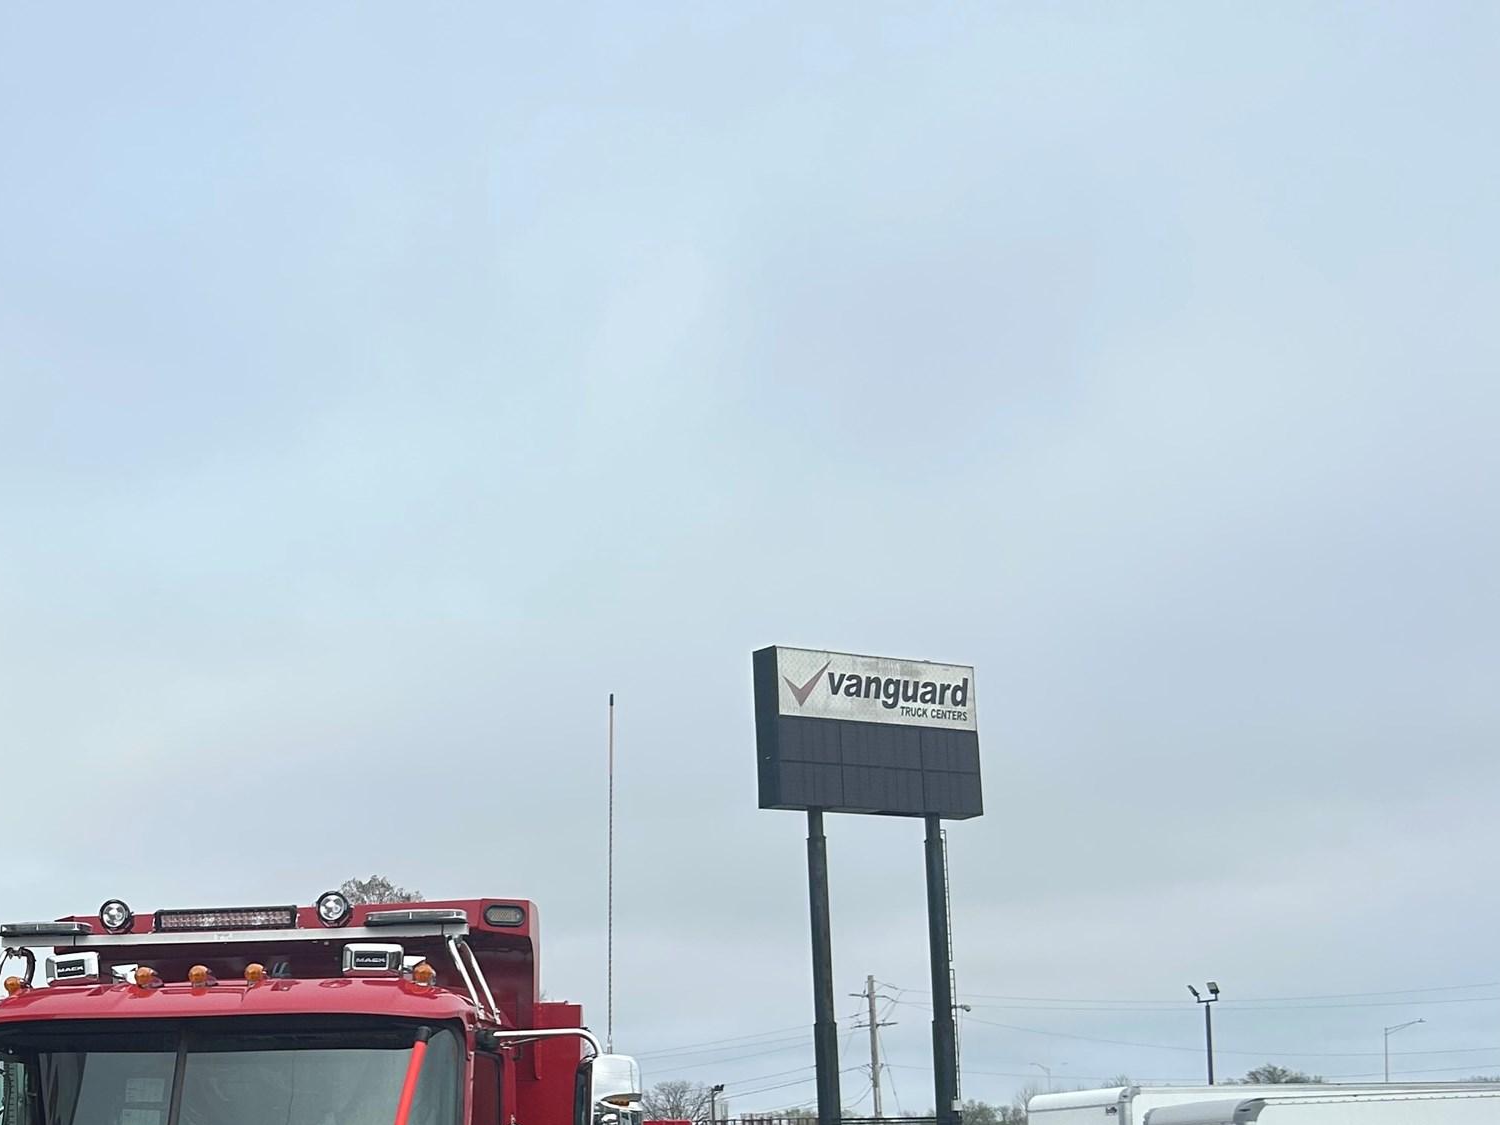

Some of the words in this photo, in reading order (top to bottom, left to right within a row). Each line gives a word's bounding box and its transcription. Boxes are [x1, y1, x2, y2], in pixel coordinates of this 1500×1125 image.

[827, 671, 969, 709] vanguard
[900, 706, 928, 718] TRUCK
[930, 708, 968, 722] CENTERS
